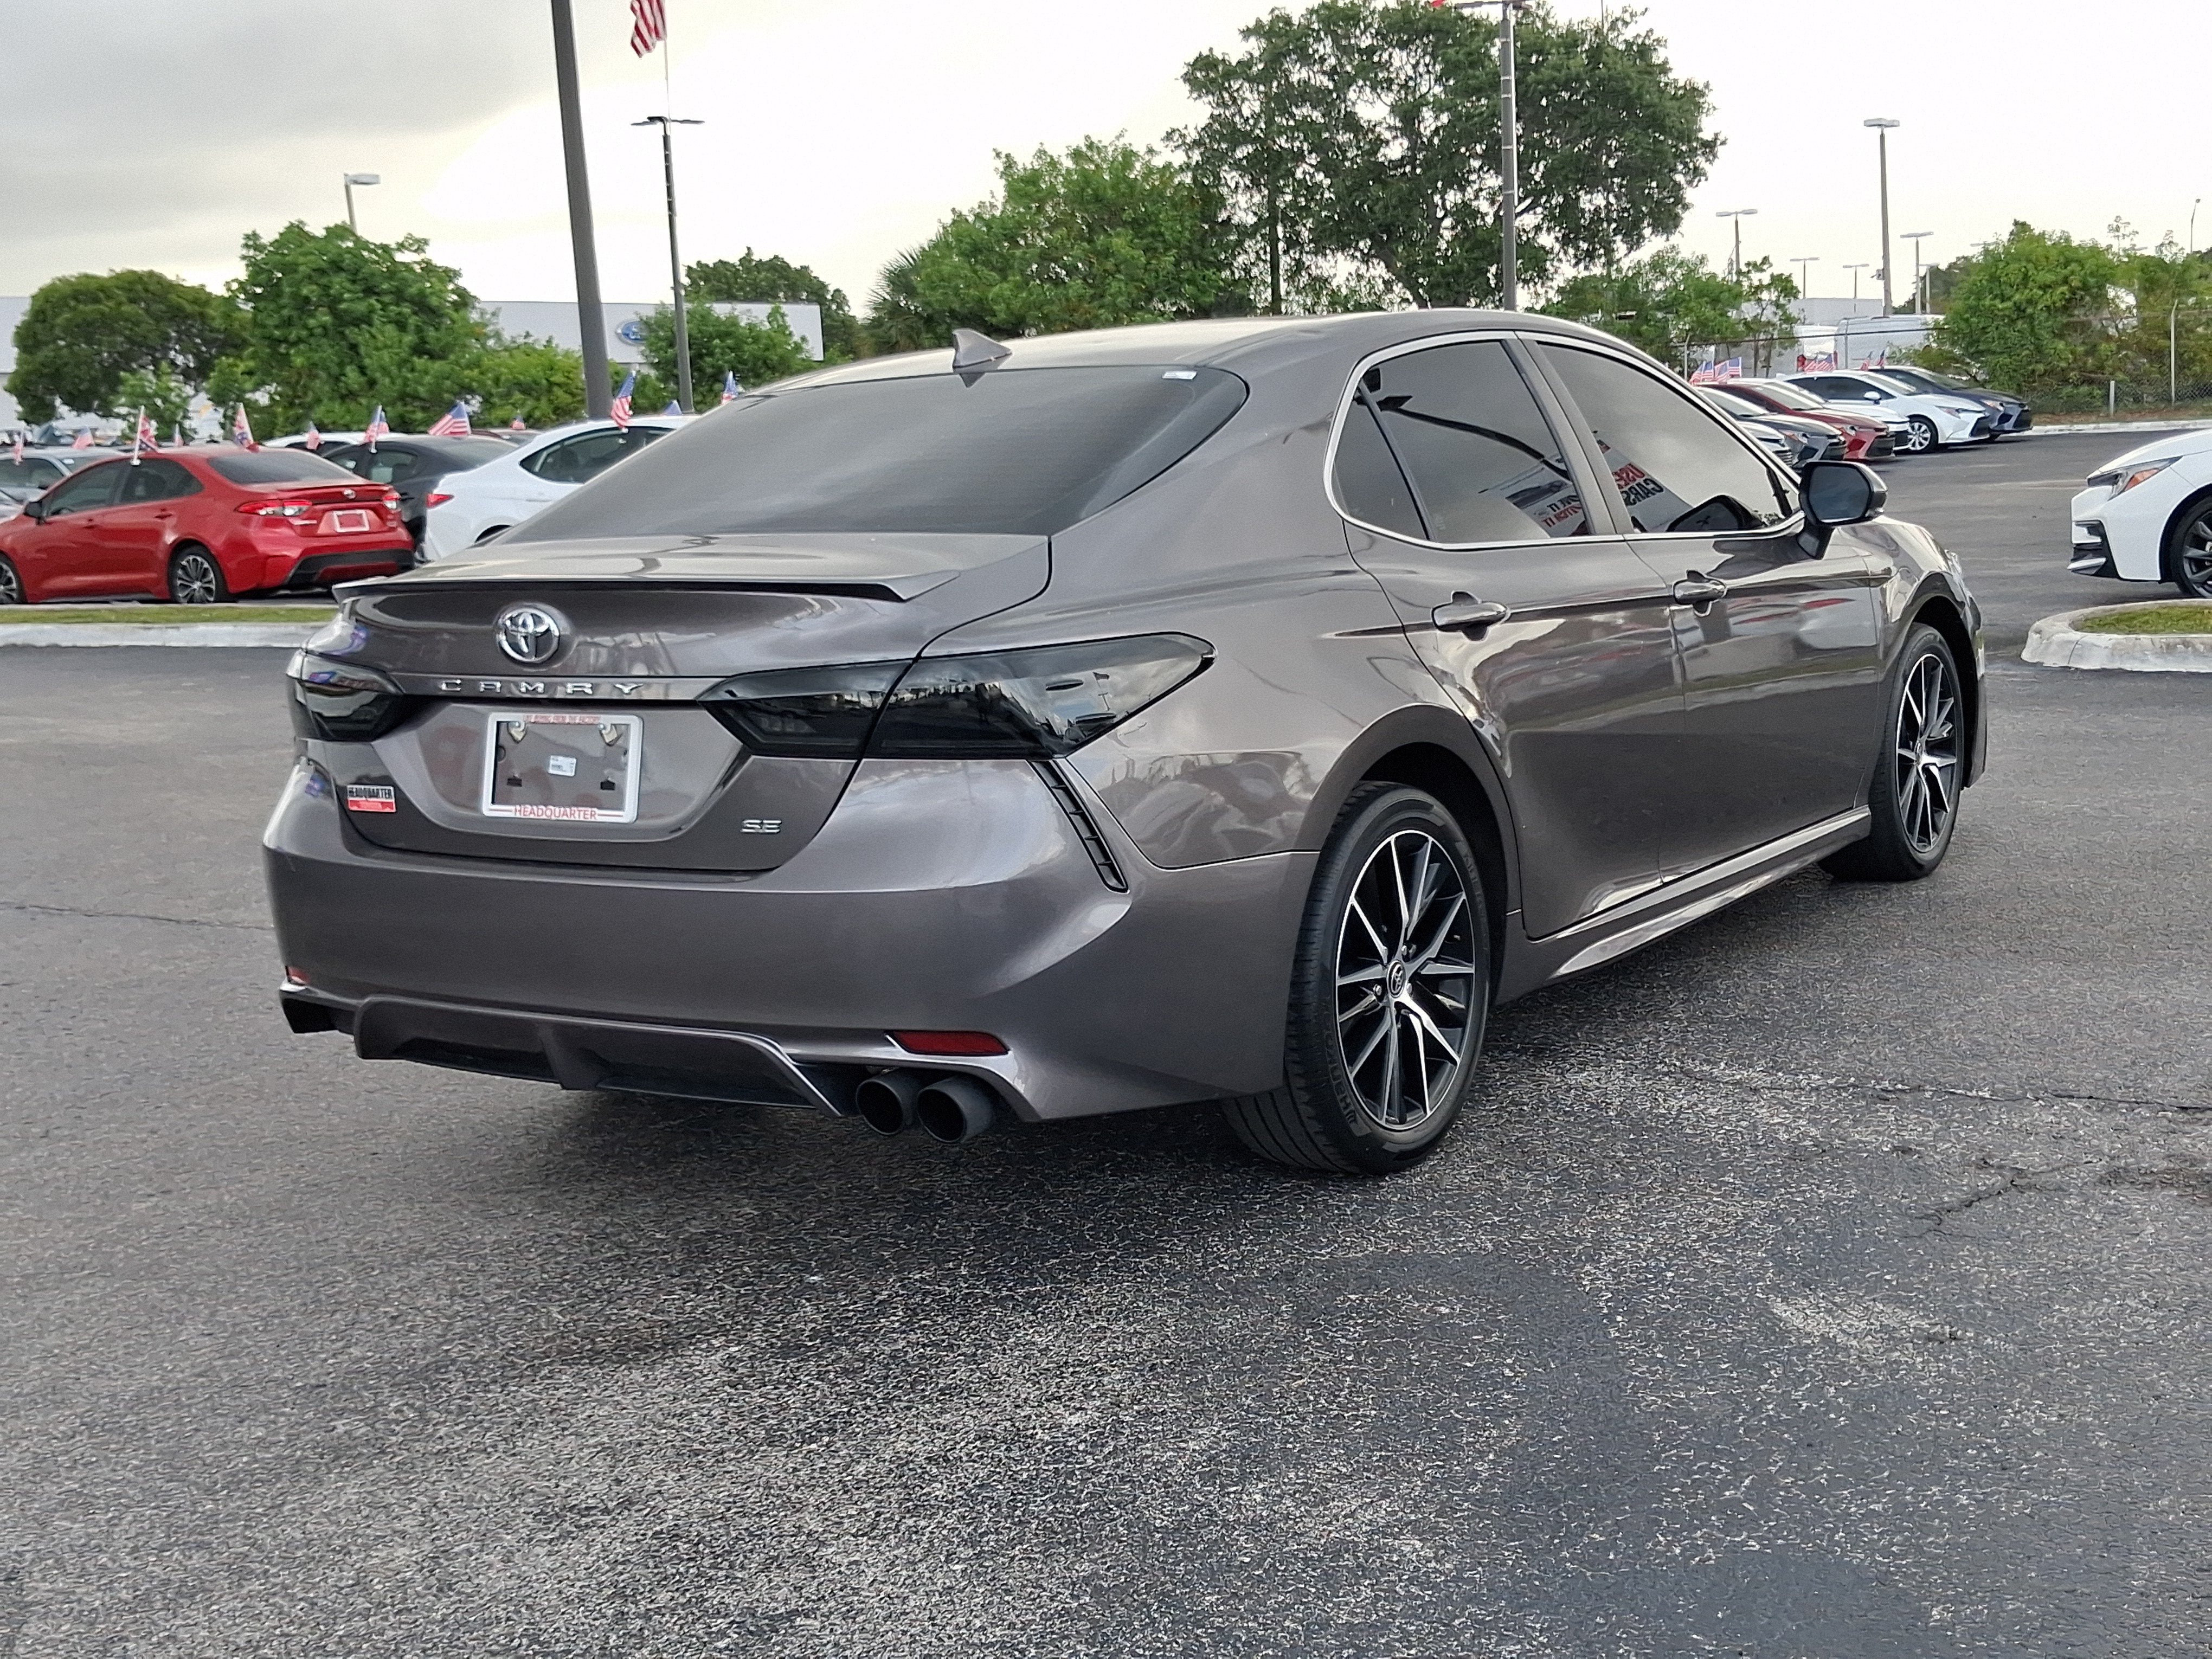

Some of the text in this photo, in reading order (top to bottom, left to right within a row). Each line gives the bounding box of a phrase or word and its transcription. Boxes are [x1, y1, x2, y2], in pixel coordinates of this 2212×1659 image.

[440, 679, 644, 695] CAMRY
[515, 805, 597, 820] HEADQUARTER
[740, 819, 782, 833] SE
